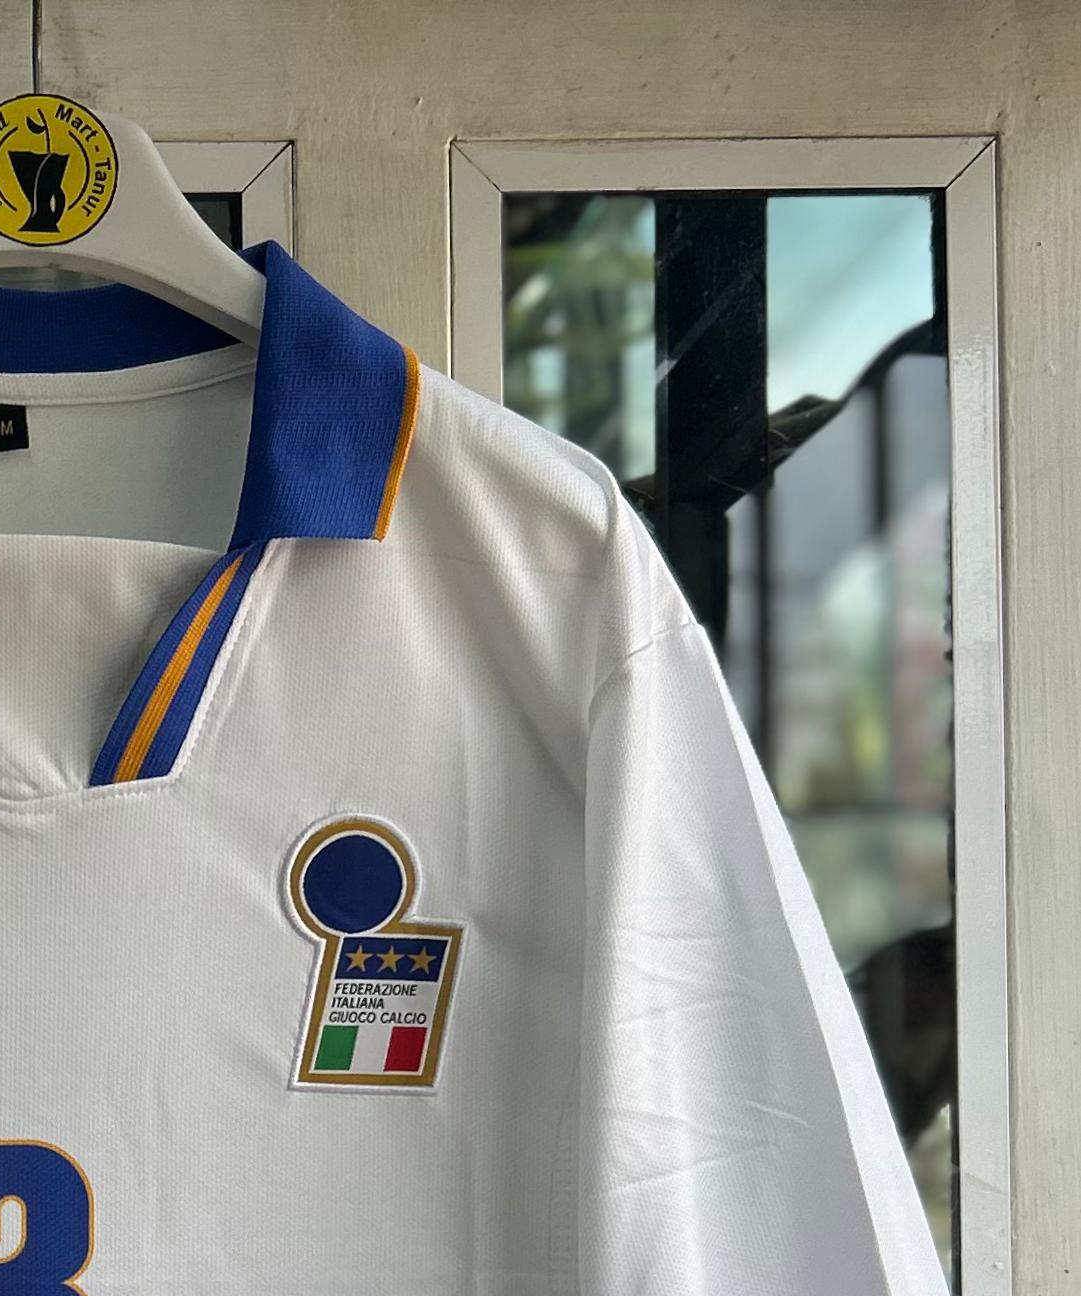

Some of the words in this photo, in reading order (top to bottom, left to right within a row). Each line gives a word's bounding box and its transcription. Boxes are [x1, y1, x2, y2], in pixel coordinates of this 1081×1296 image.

[55, 104, 99, 142] Mart
[82, 157, 112, 217] Tanur
[0, 420, 14, 436] M
[334, 983, 418, 996] FEDERAZIONE
[331, 997, 384, 1009] ITALIANA
[328, 1011, 376, 1023] GIUOCO
[380, 1012, 427, 1024] CALCIO
